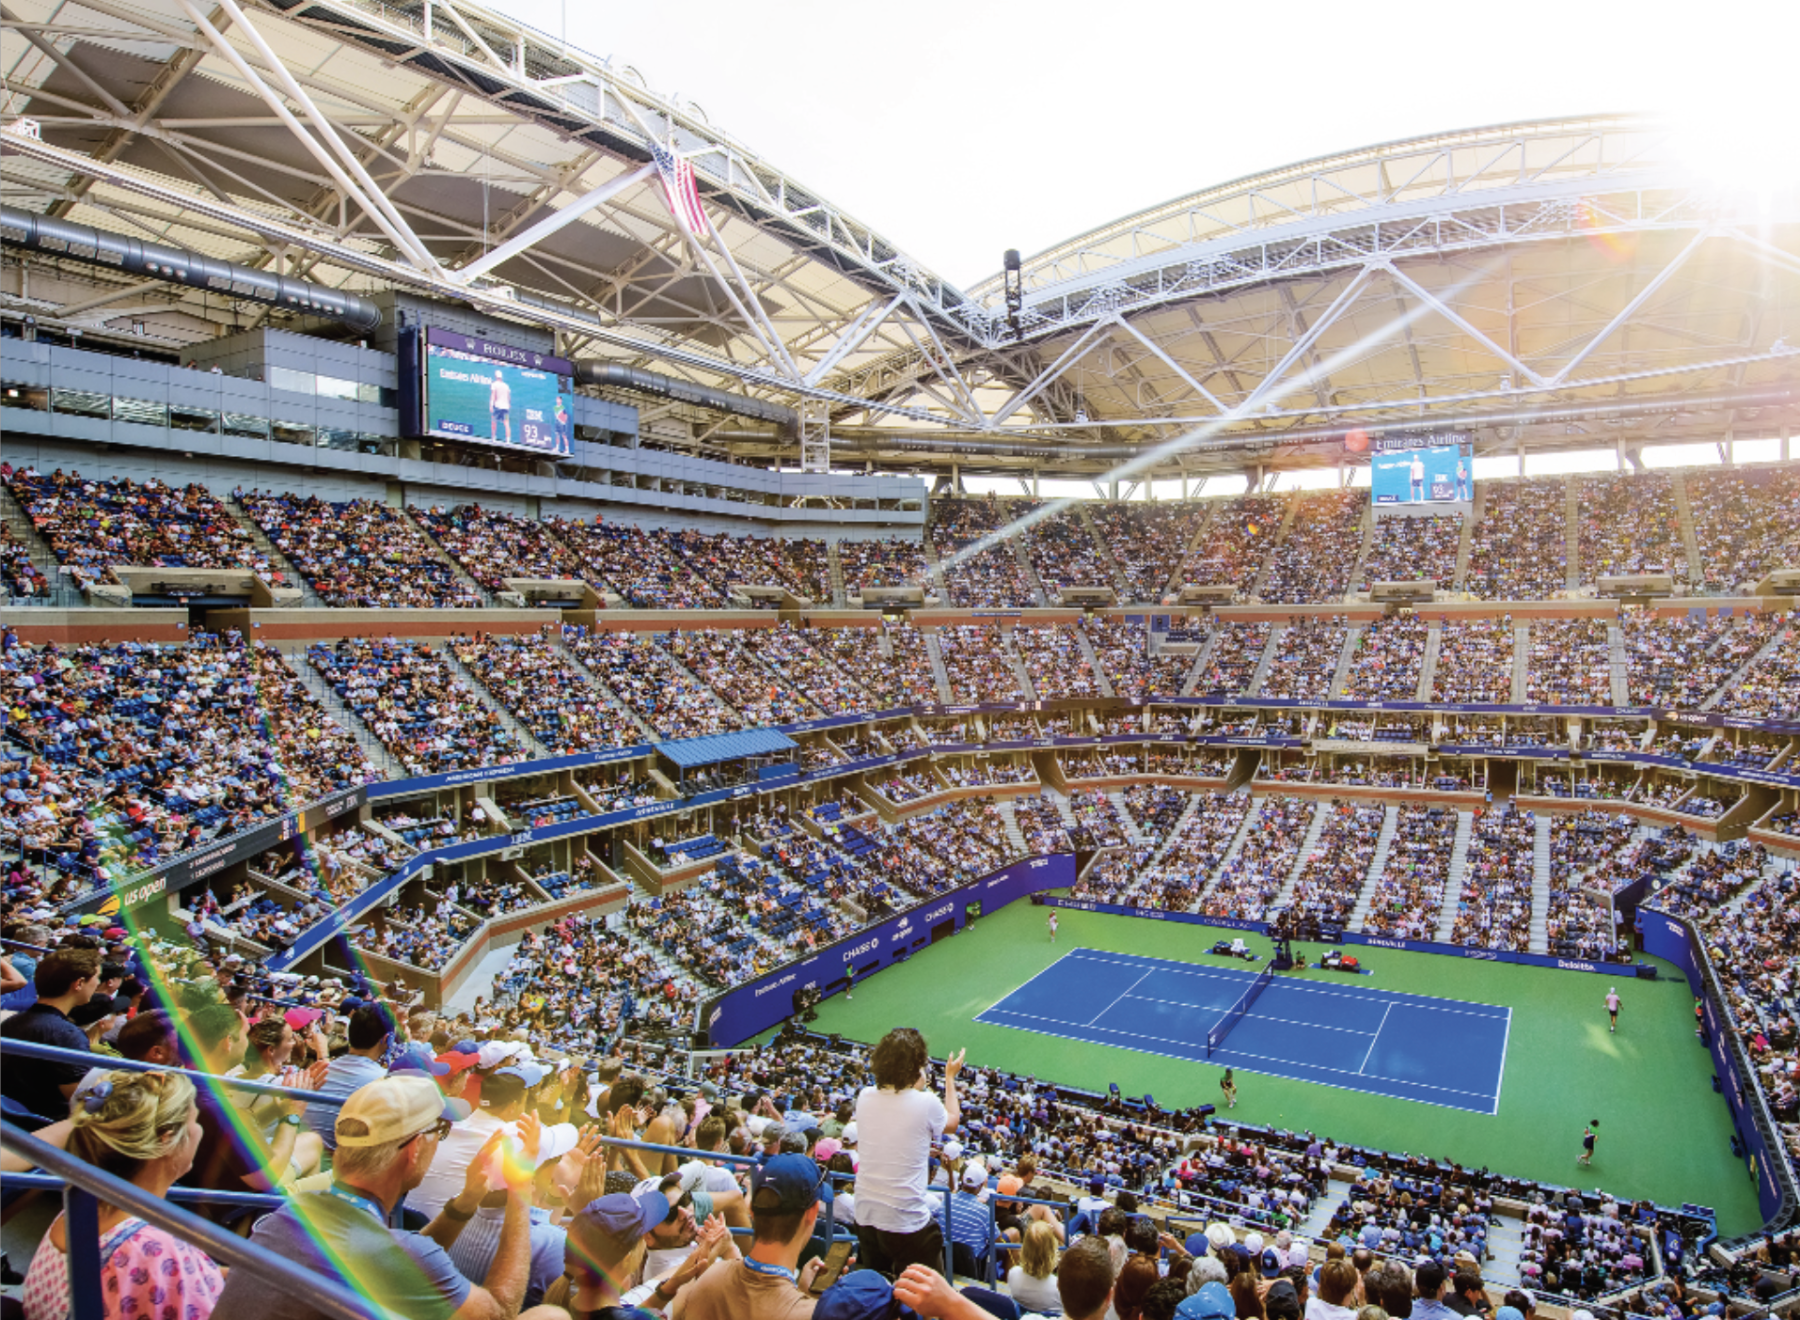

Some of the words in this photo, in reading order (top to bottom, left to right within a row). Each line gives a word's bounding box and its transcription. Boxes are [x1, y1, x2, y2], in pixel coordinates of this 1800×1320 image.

[483, 343, 527, 362] ROLEX
[442, 421, 469, 433] DEUCE
[523, 424, 538, 438] 93
[1376, 438, 1424, 450] Emirates
[1428, 433, 1466, 446] Airline
[124, 889, 139, 906] us
[138, 876, 166, 902] open
[843, 941, 871, 962] CHASE
